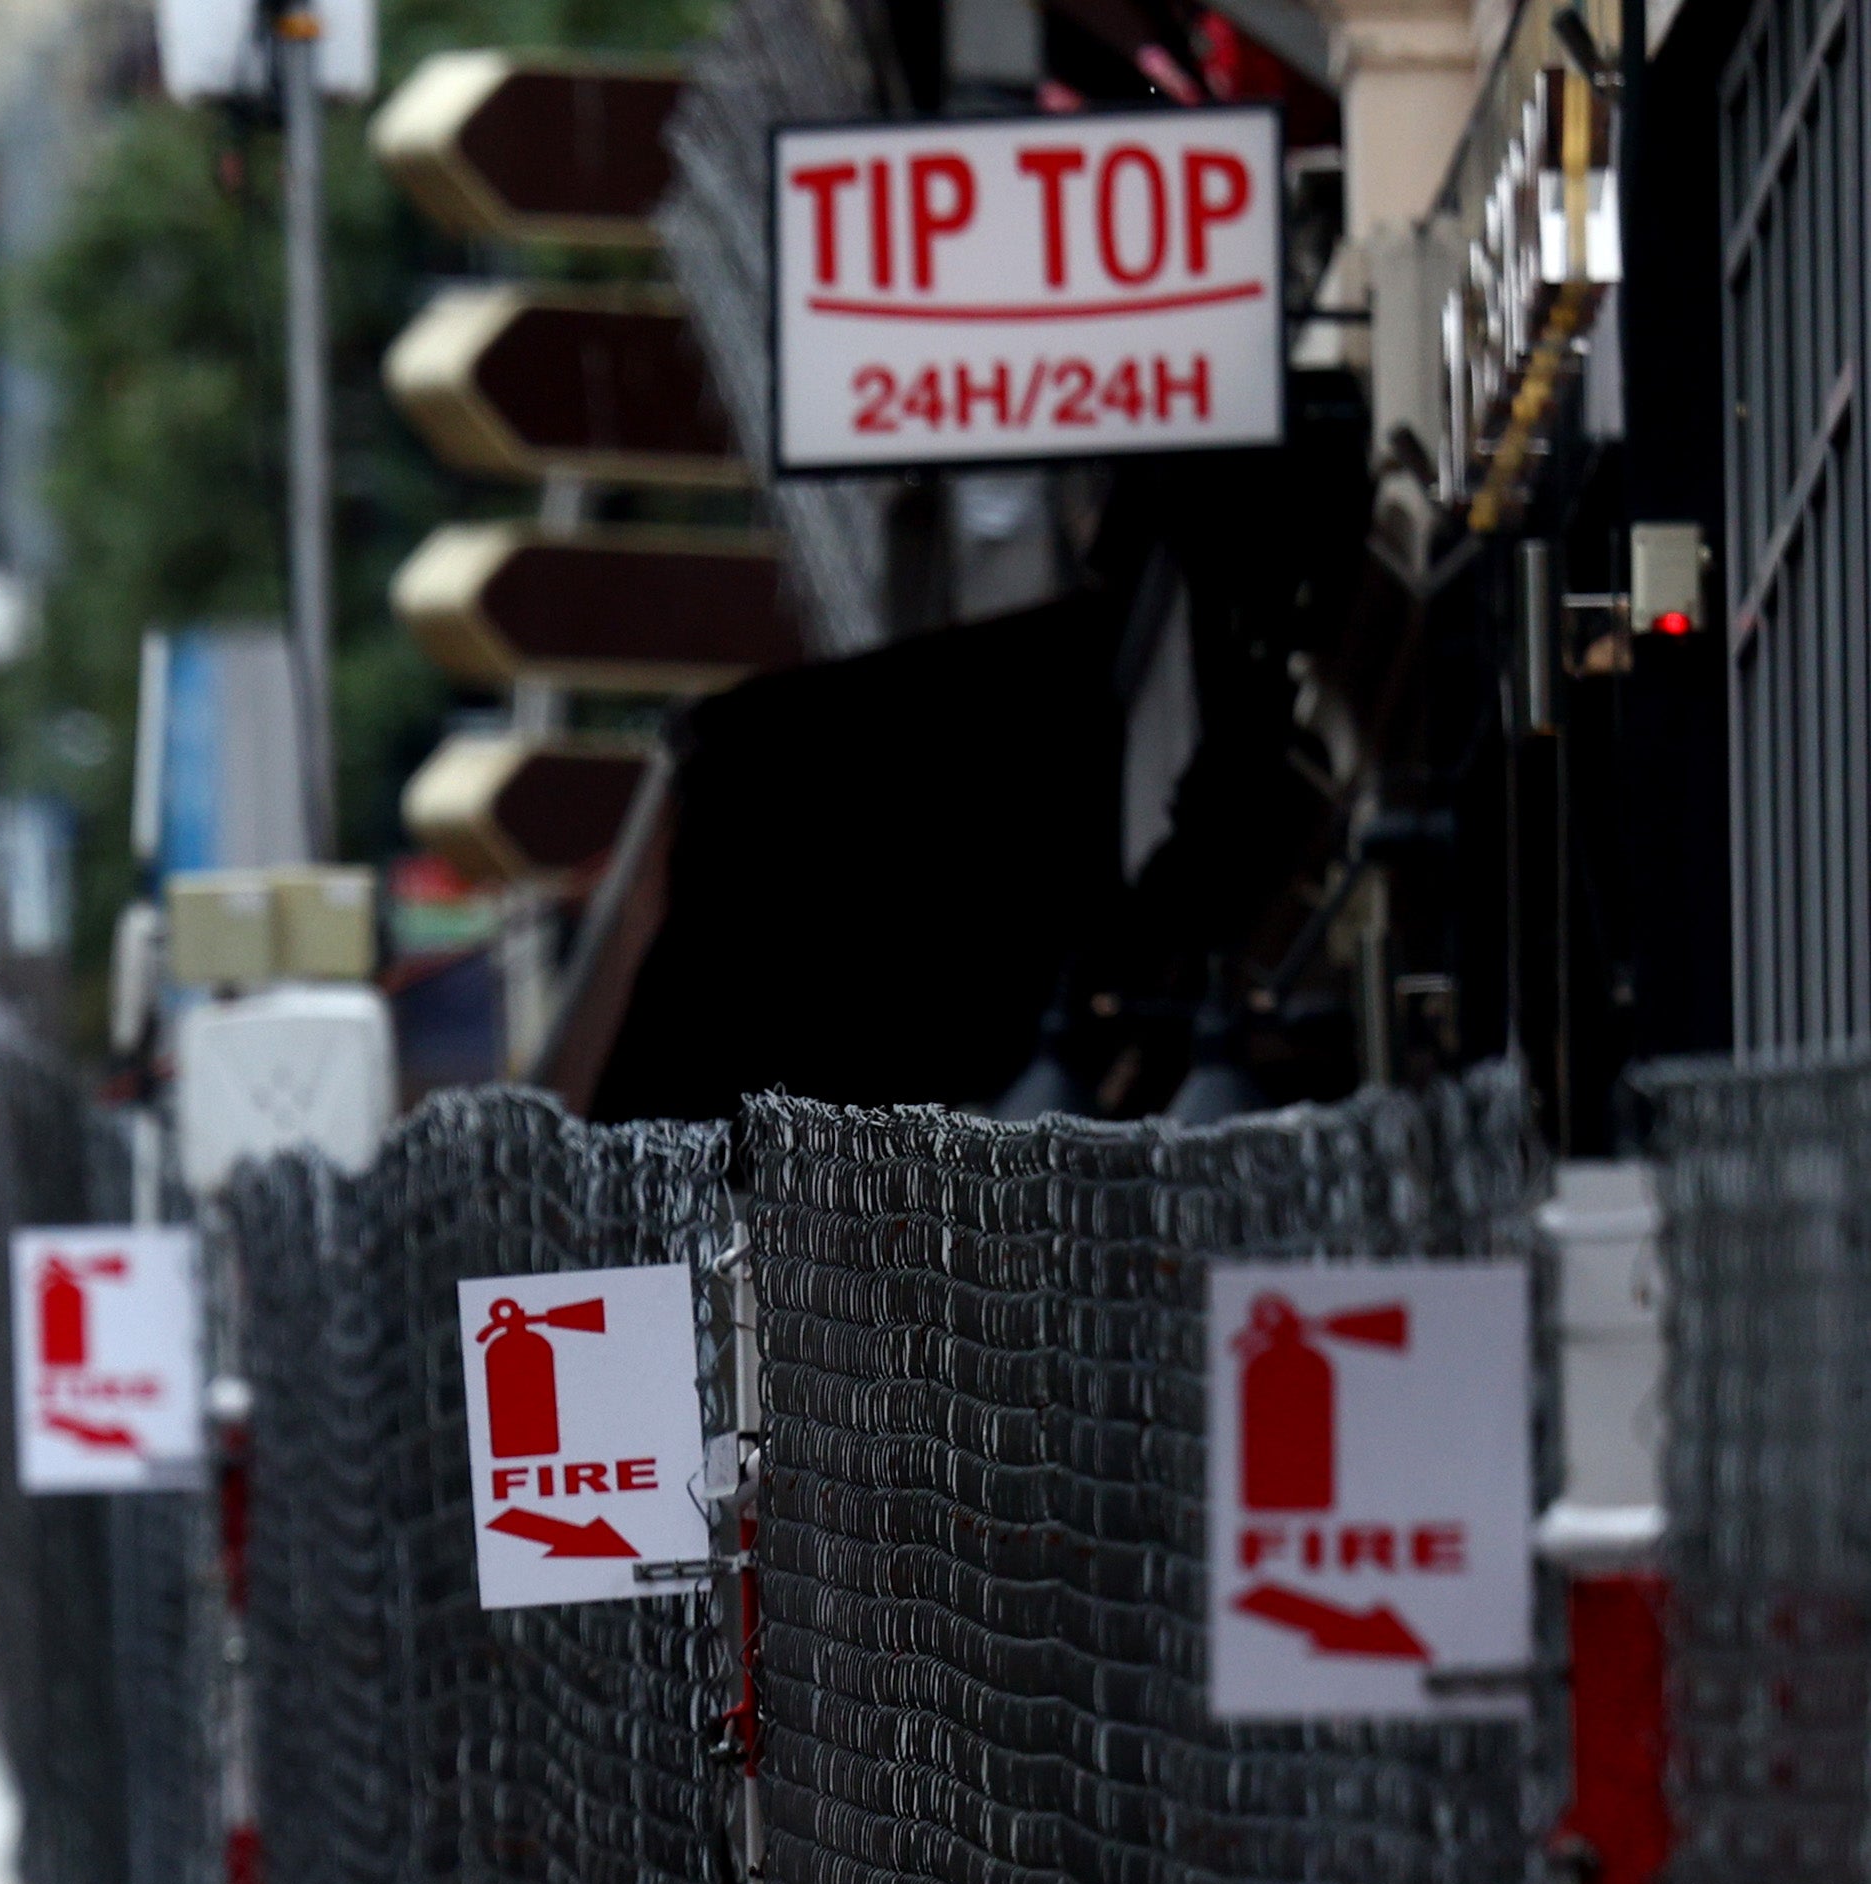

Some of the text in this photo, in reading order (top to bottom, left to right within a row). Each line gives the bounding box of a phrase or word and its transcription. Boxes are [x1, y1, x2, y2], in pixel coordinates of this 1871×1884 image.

[789, 144, 1251, 291] TIP TOP
[852, 353, 1211, 434] 24H/24H
[491, 1458, 658, 1500] FIRE
[1238, 1522, 1465, 1573] FIRE
